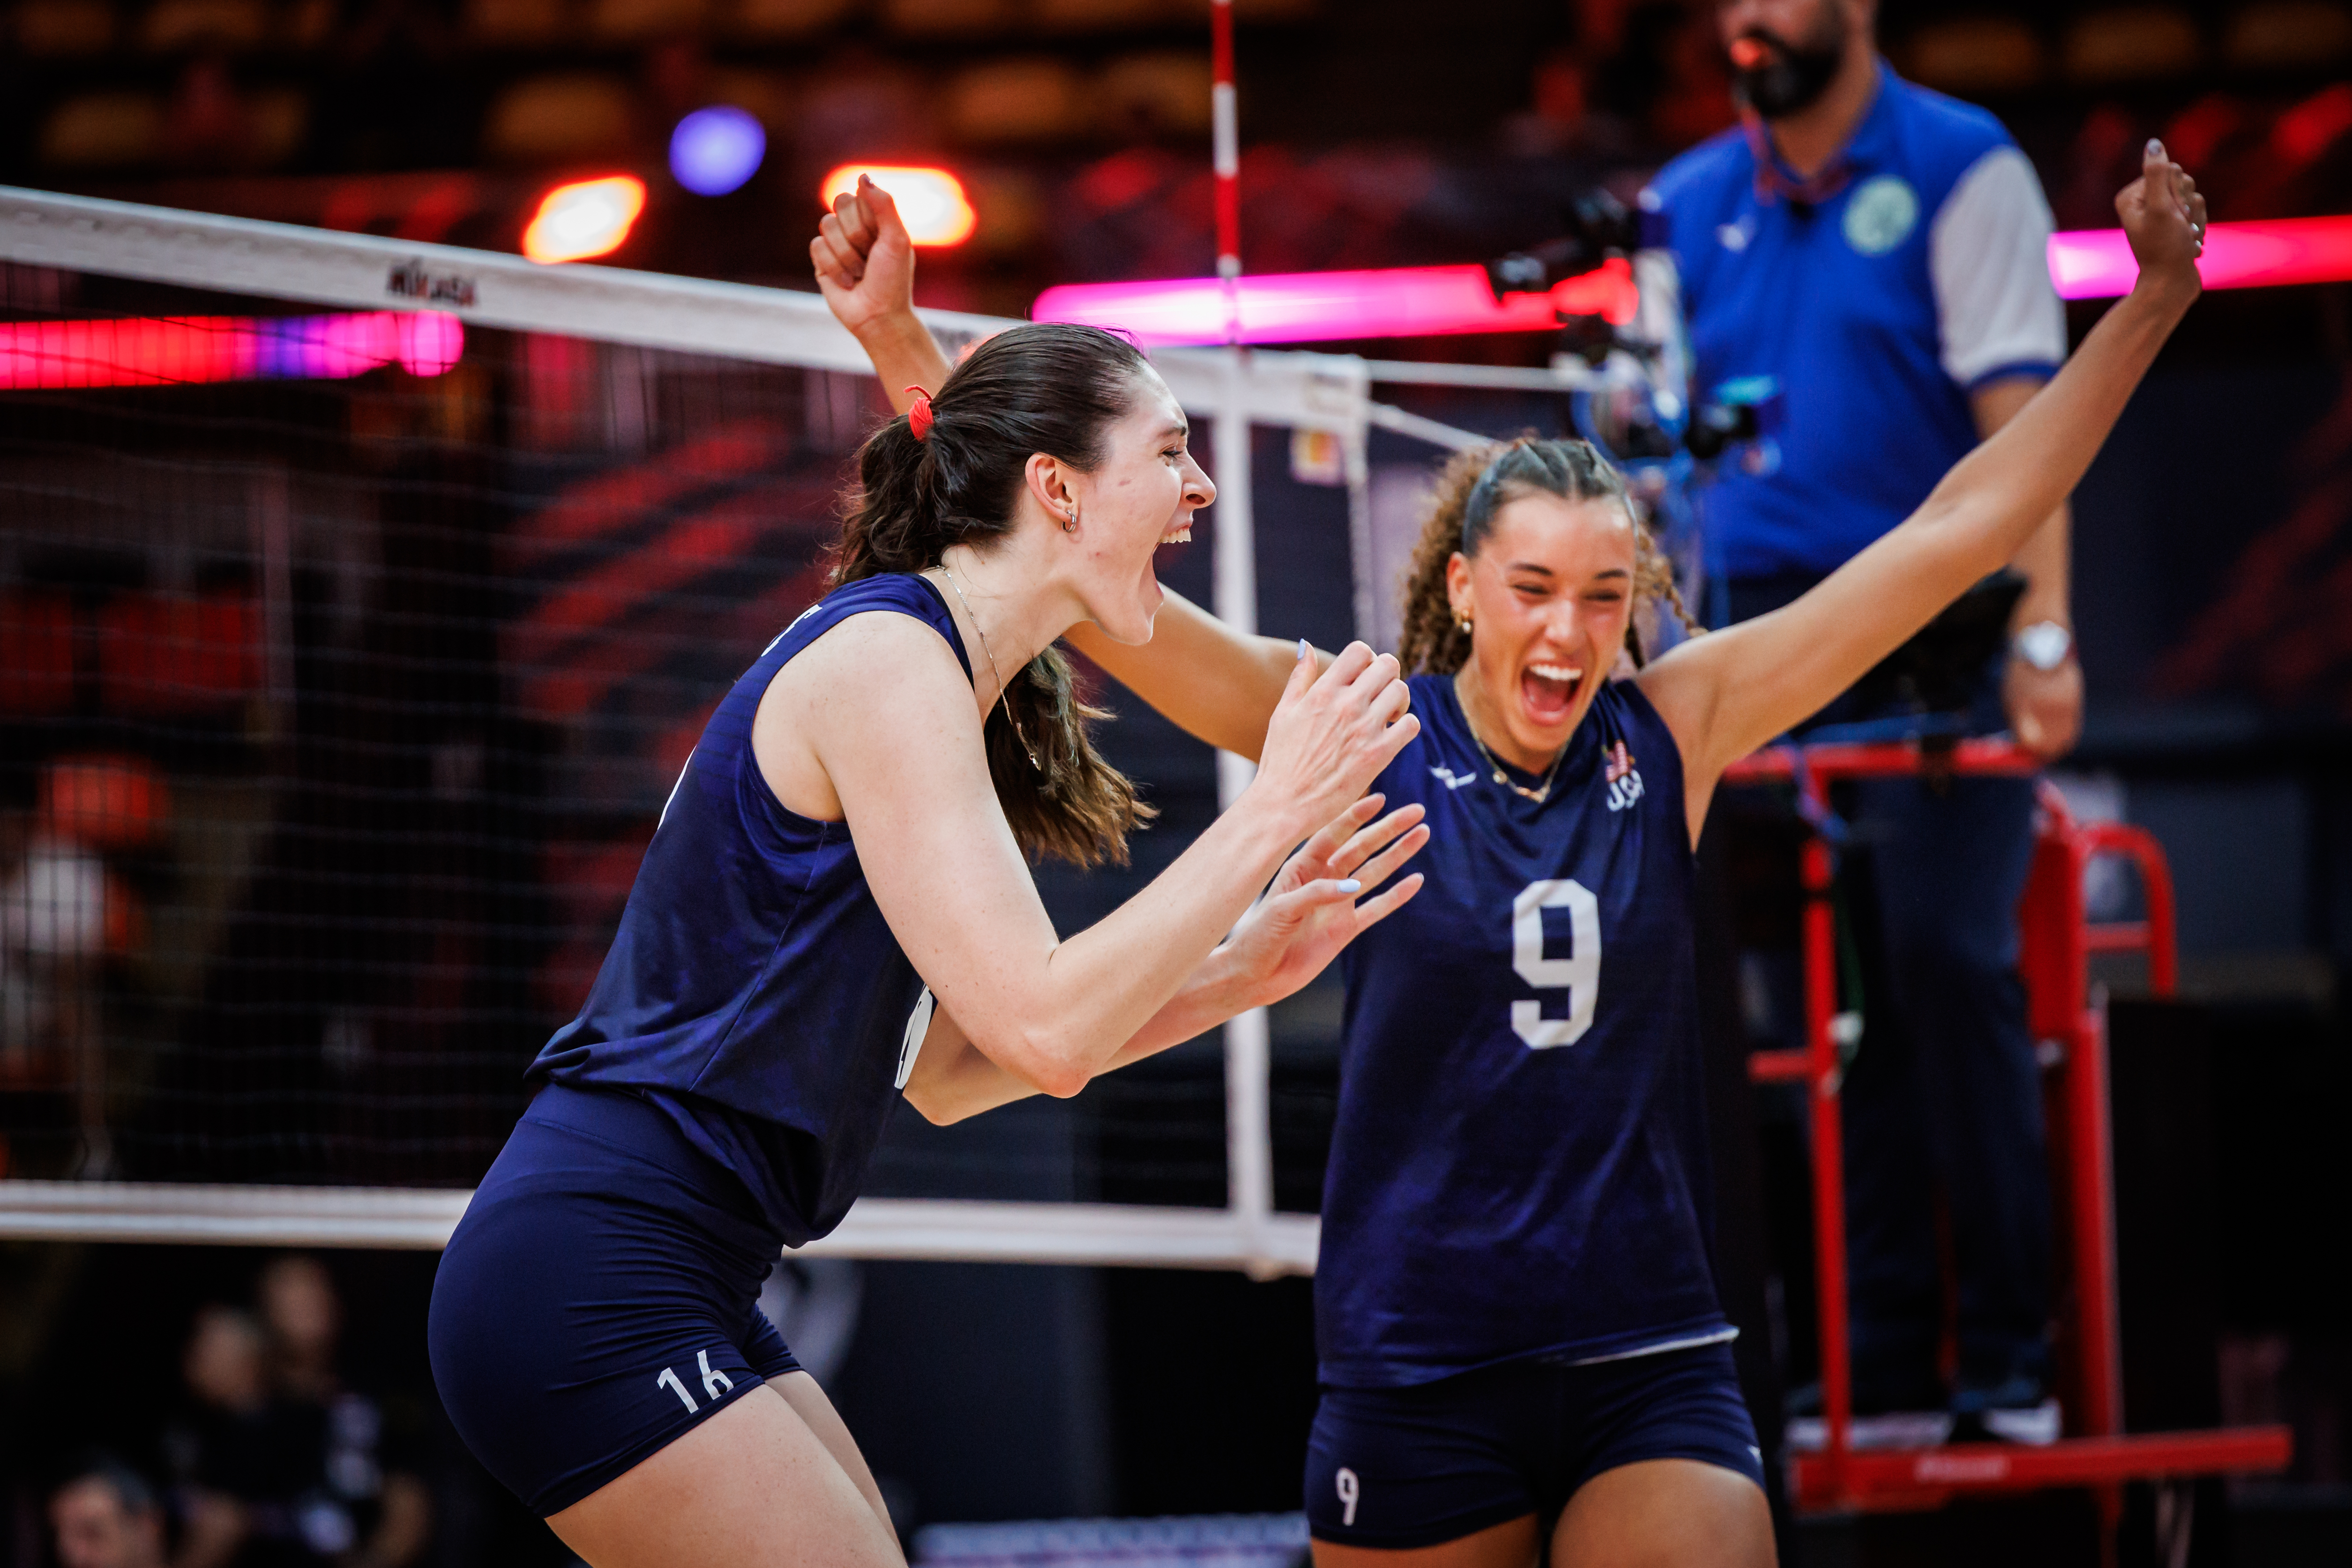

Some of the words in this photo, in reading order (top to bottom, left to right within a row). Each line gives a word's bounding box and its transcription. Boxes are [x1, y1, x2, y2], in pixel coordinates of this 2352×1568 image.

[1511, 879, 1602, 1050] 9
[657, 1350, 734, 1414] 16
[1336, 1467, 1359, 1526] 9
